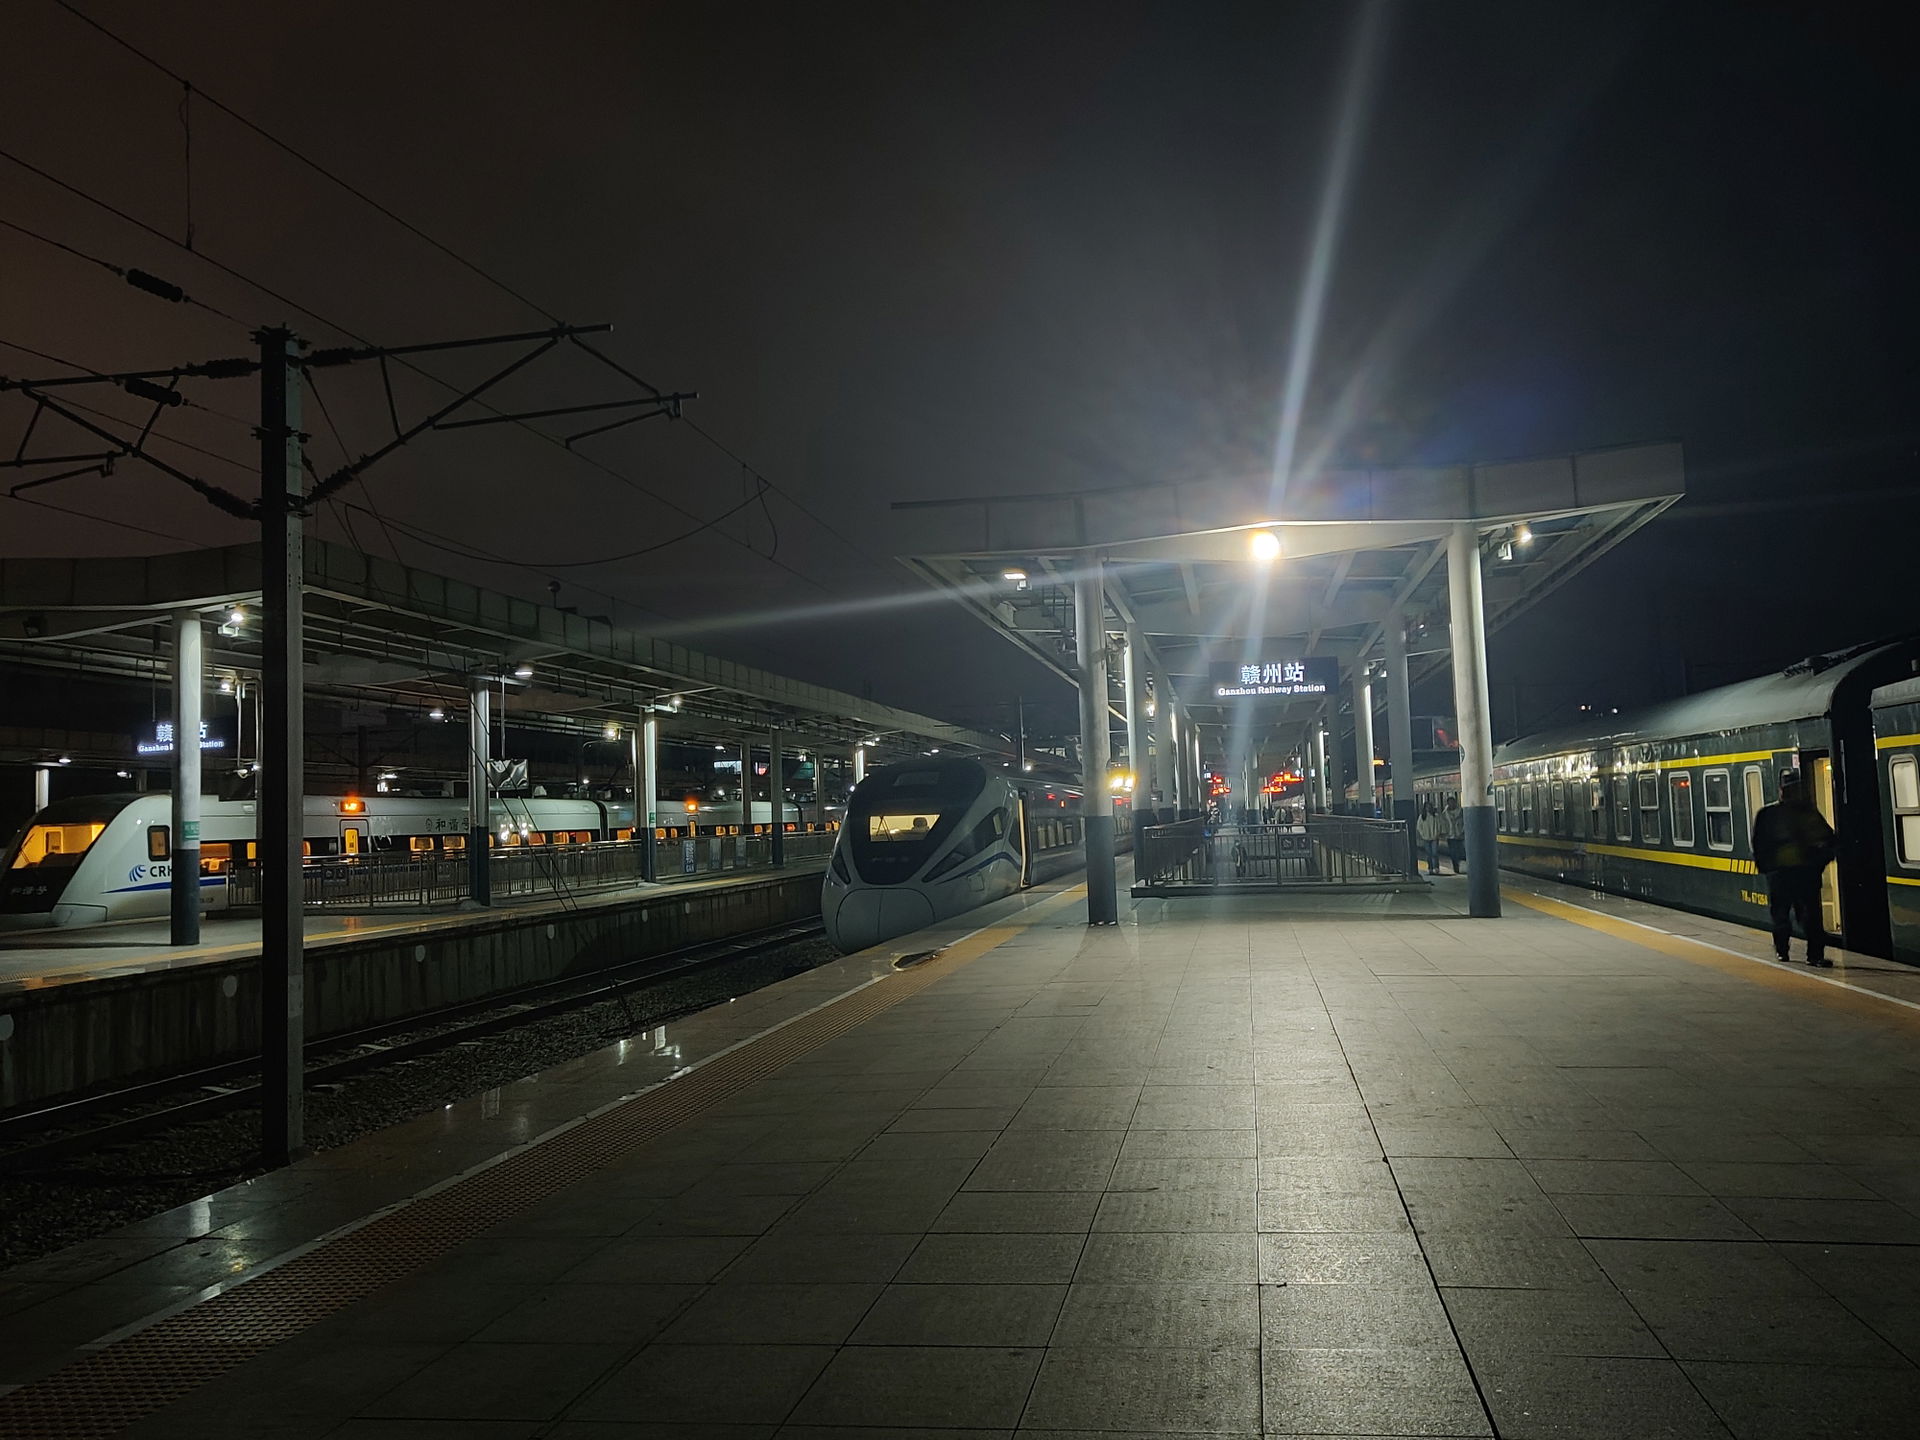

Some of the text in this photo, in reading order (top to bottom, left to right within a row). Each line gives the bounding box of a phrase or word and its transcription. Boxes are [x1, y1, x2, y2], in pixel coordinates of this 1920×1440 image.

[1241, 662, 1304, 684] 赣州站
[1218, 684, 1326, 696] Ganzhou Railway Station
